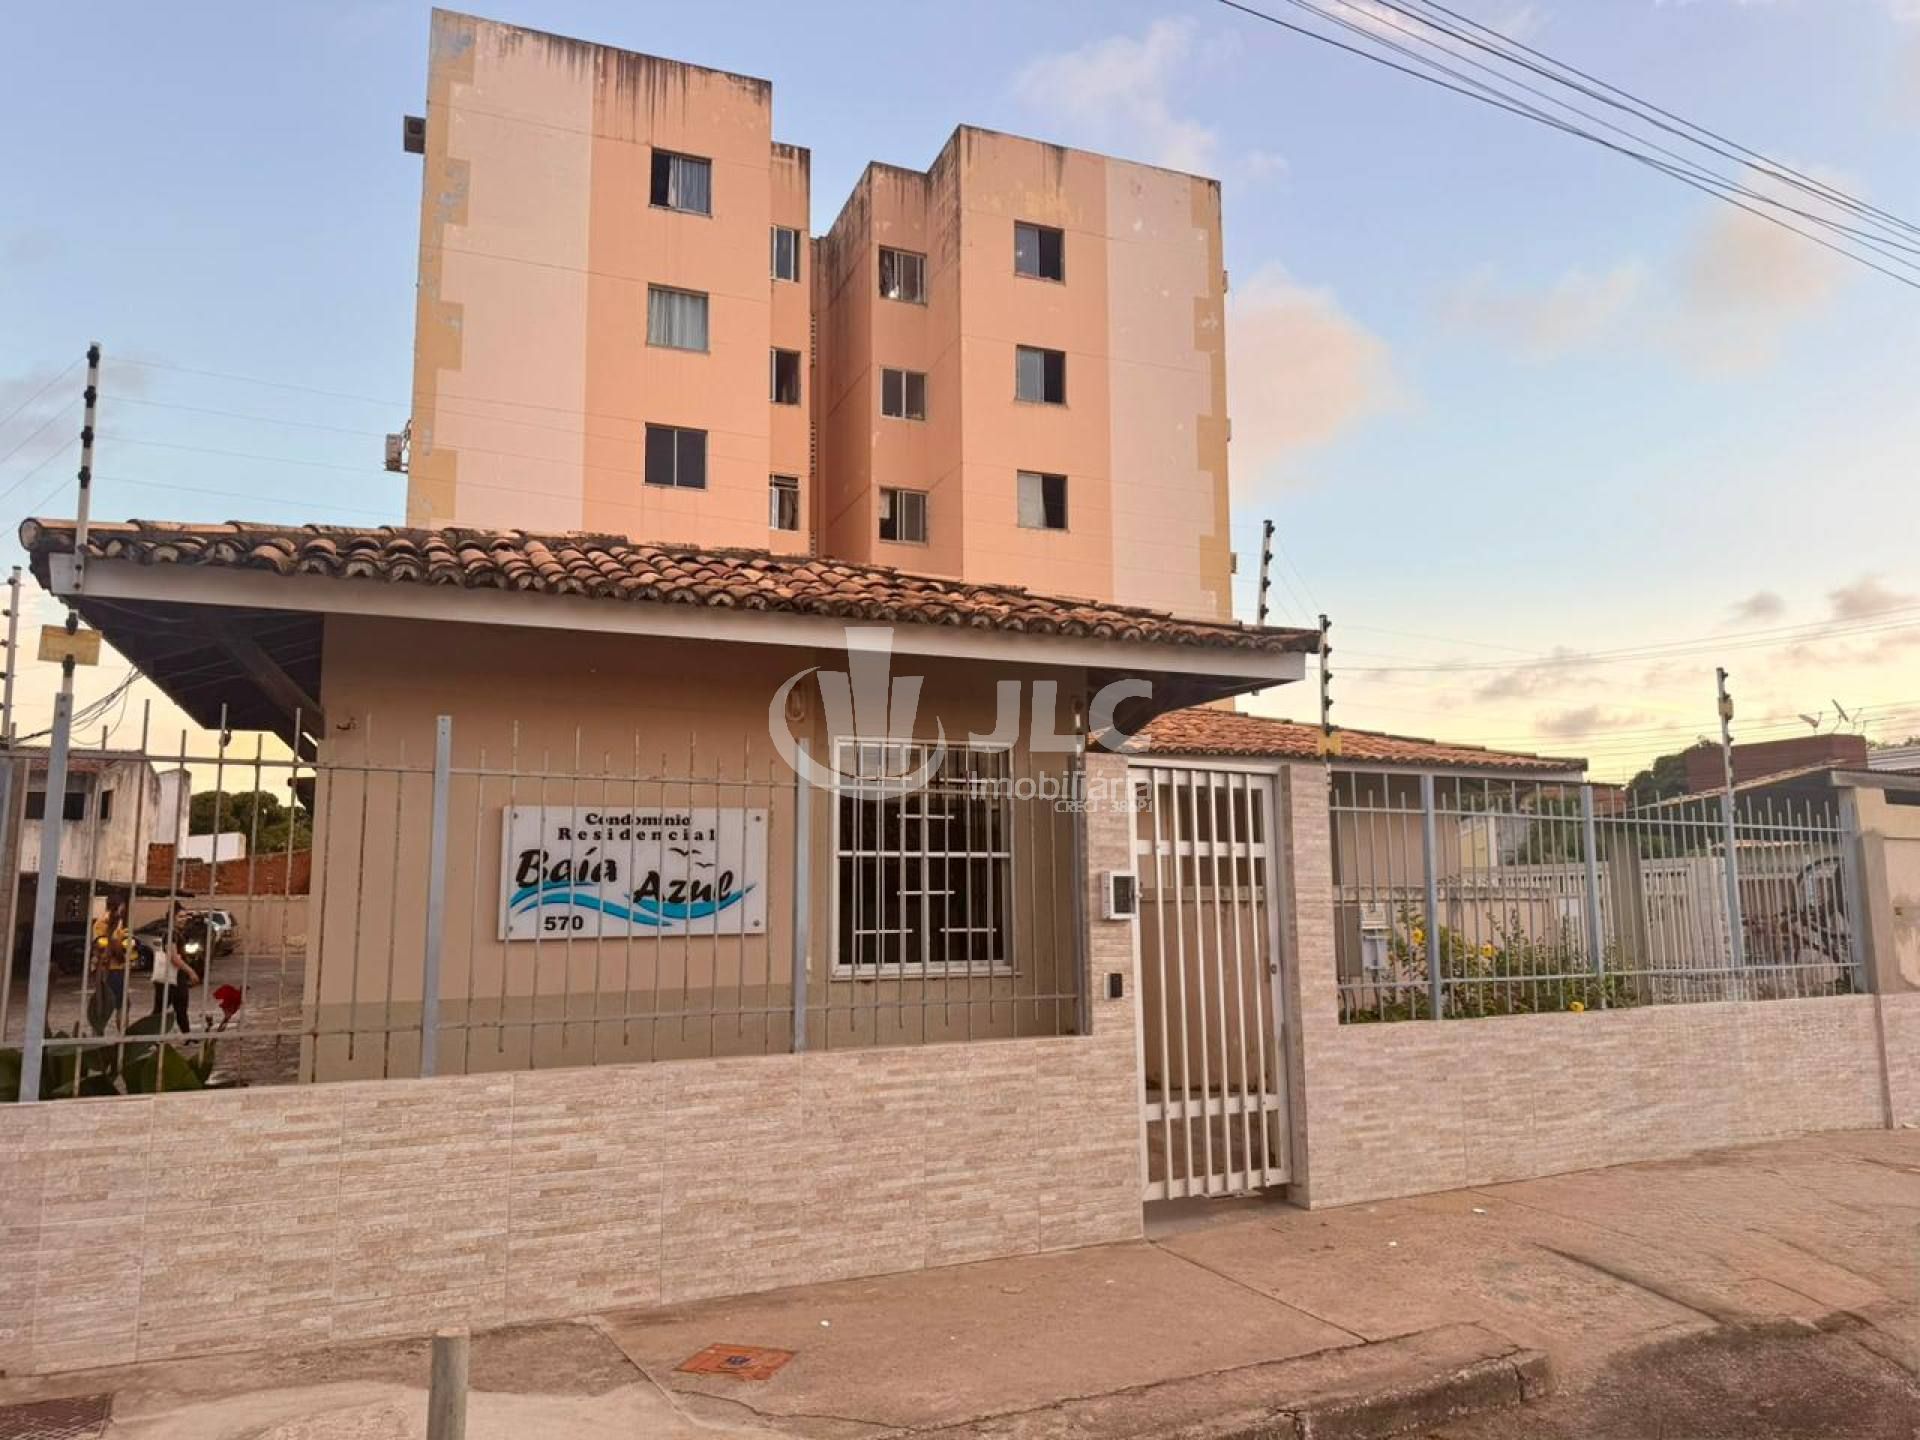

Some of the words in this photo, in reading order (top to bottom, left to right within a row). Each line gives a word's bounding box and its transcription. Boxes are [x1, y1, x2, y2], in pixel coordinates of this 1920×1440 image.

[558, 827, 716, 841] Residencial
[632, 870, 735, 903] Azul
[544, 915, 584, 930] 570
